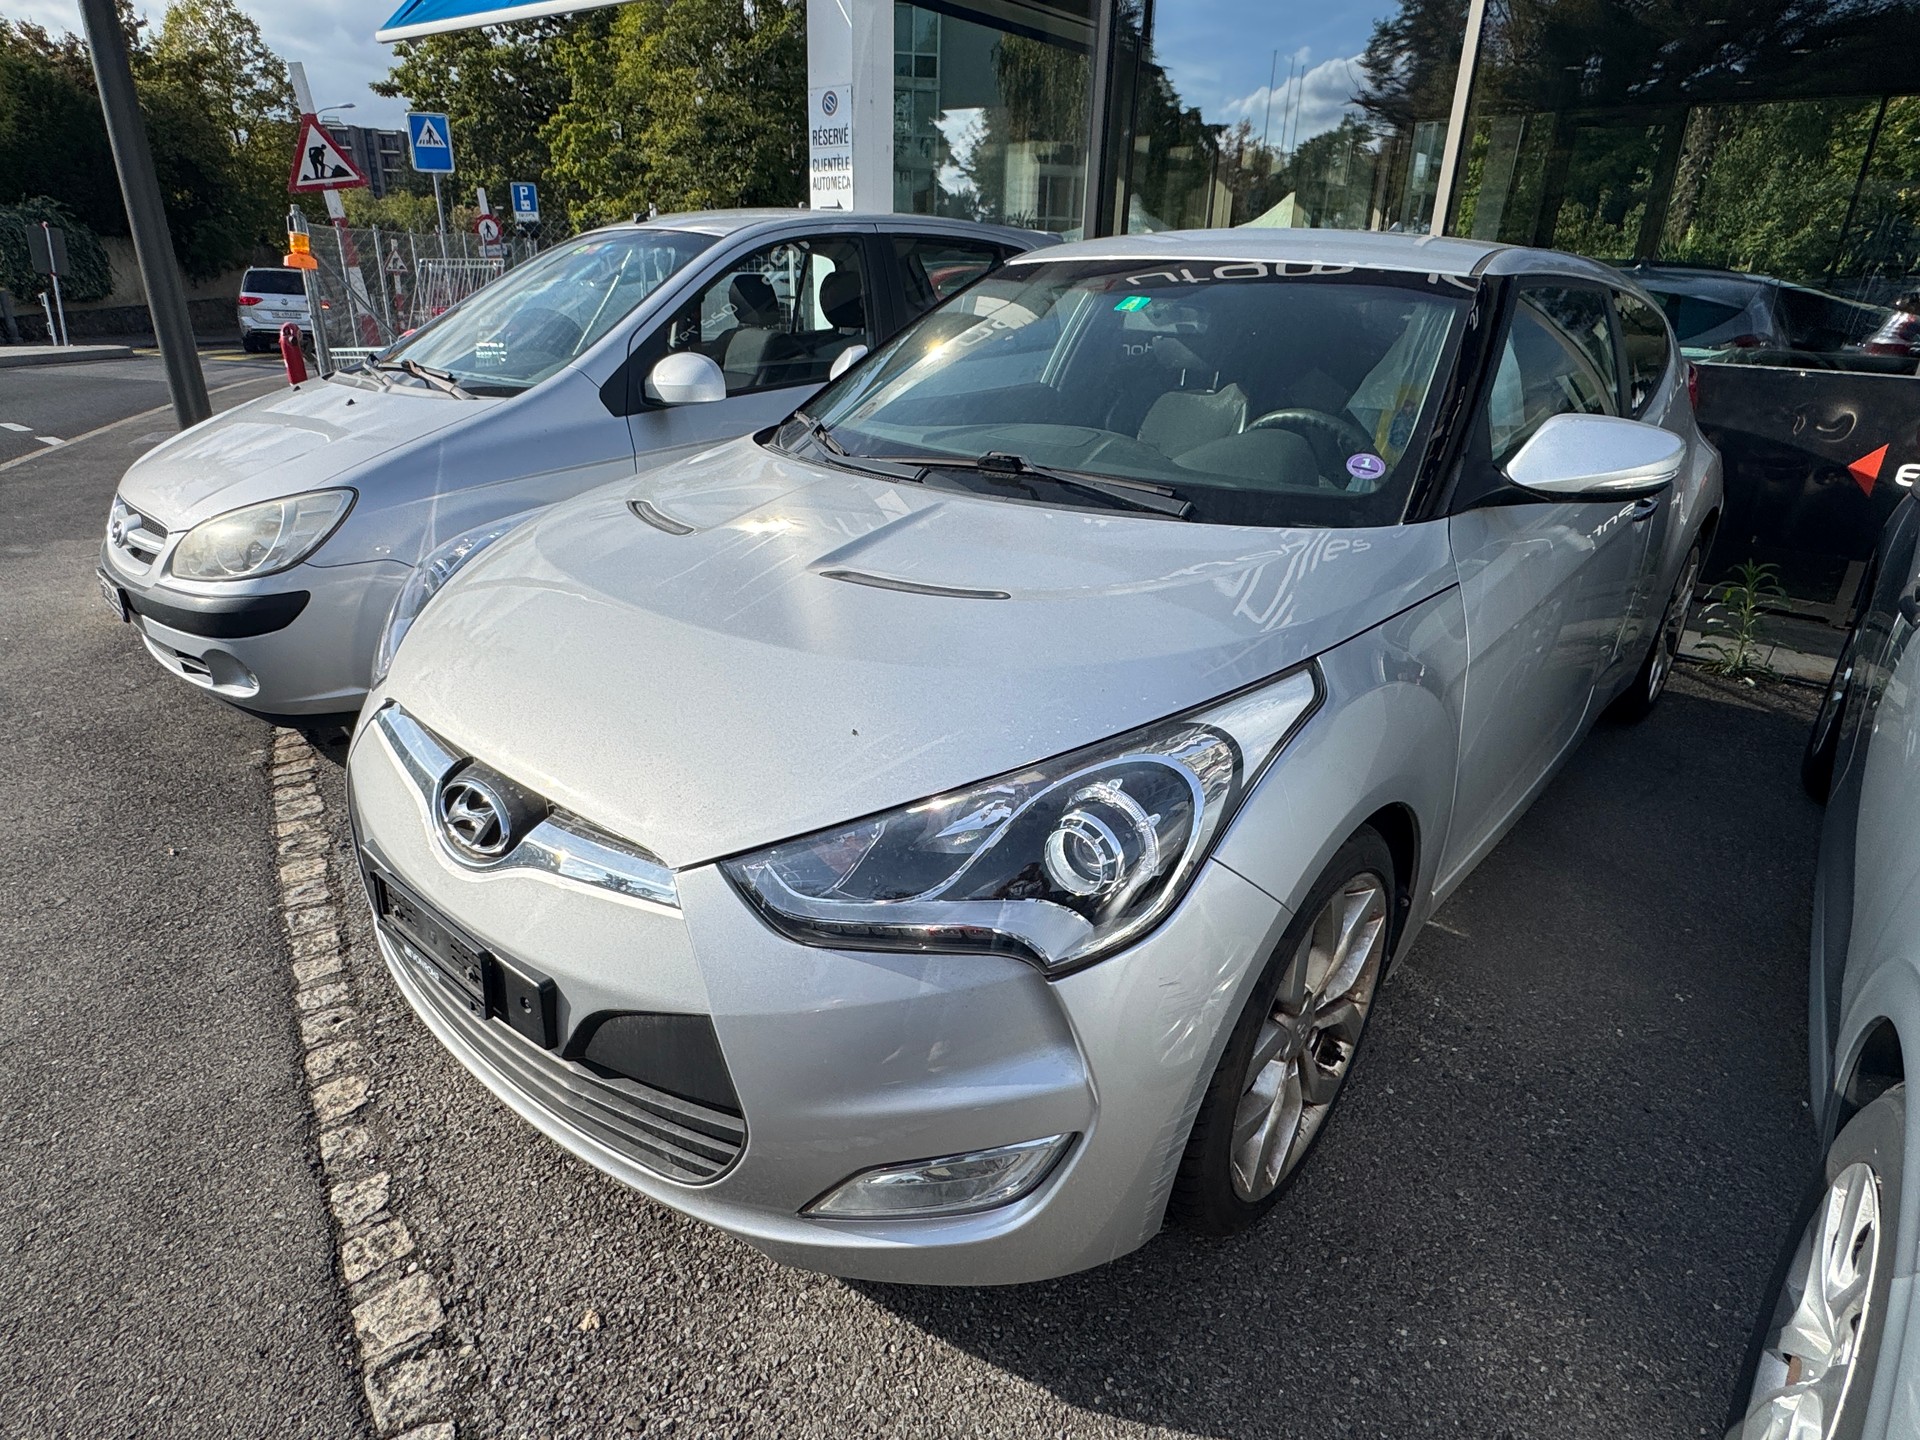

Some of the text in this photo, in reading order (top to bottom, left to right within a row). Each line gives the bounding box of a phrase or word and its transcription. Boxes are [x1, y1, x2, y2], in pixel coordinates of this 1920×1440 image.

[812, 123, 849, 146] RÉSERVÉ
[812, 154, 850, 172] CLIENTÈLE
[812, 175, 851, 191] AUTOMECA
[1360, 457, 1372, 469] 1
